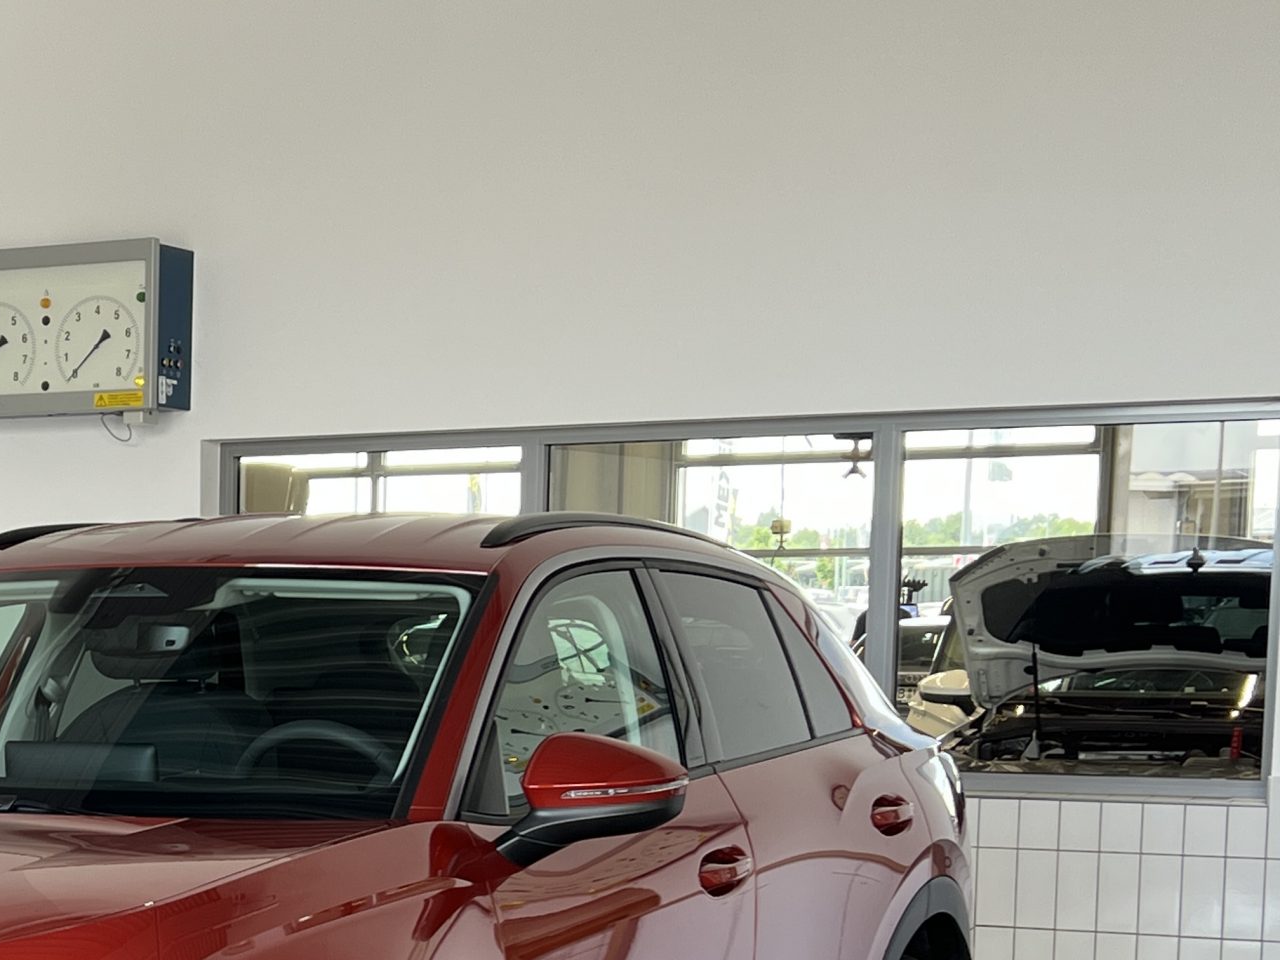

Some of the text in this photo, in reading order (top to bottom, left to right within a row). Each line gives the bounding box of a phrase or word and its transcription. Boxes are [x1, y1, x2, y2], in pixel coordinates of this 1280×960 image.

[95, 305, 100, 315] 4
[114, 309, 120, 320] 5
[11, 316, 16, 326] 5
[75, 312, 81, 322] 3
[65, 331, 70, 341] 2
[125, 327, 131, 337] 6
[21, 333, 27, 343] 6
[22, 354, 27, 364] 7
[64, 353, 68, 362] 1
[125, 349, 131, 359] 7
[13, 371, 18, 381] 8
[115, 367, 121, 376] 8
